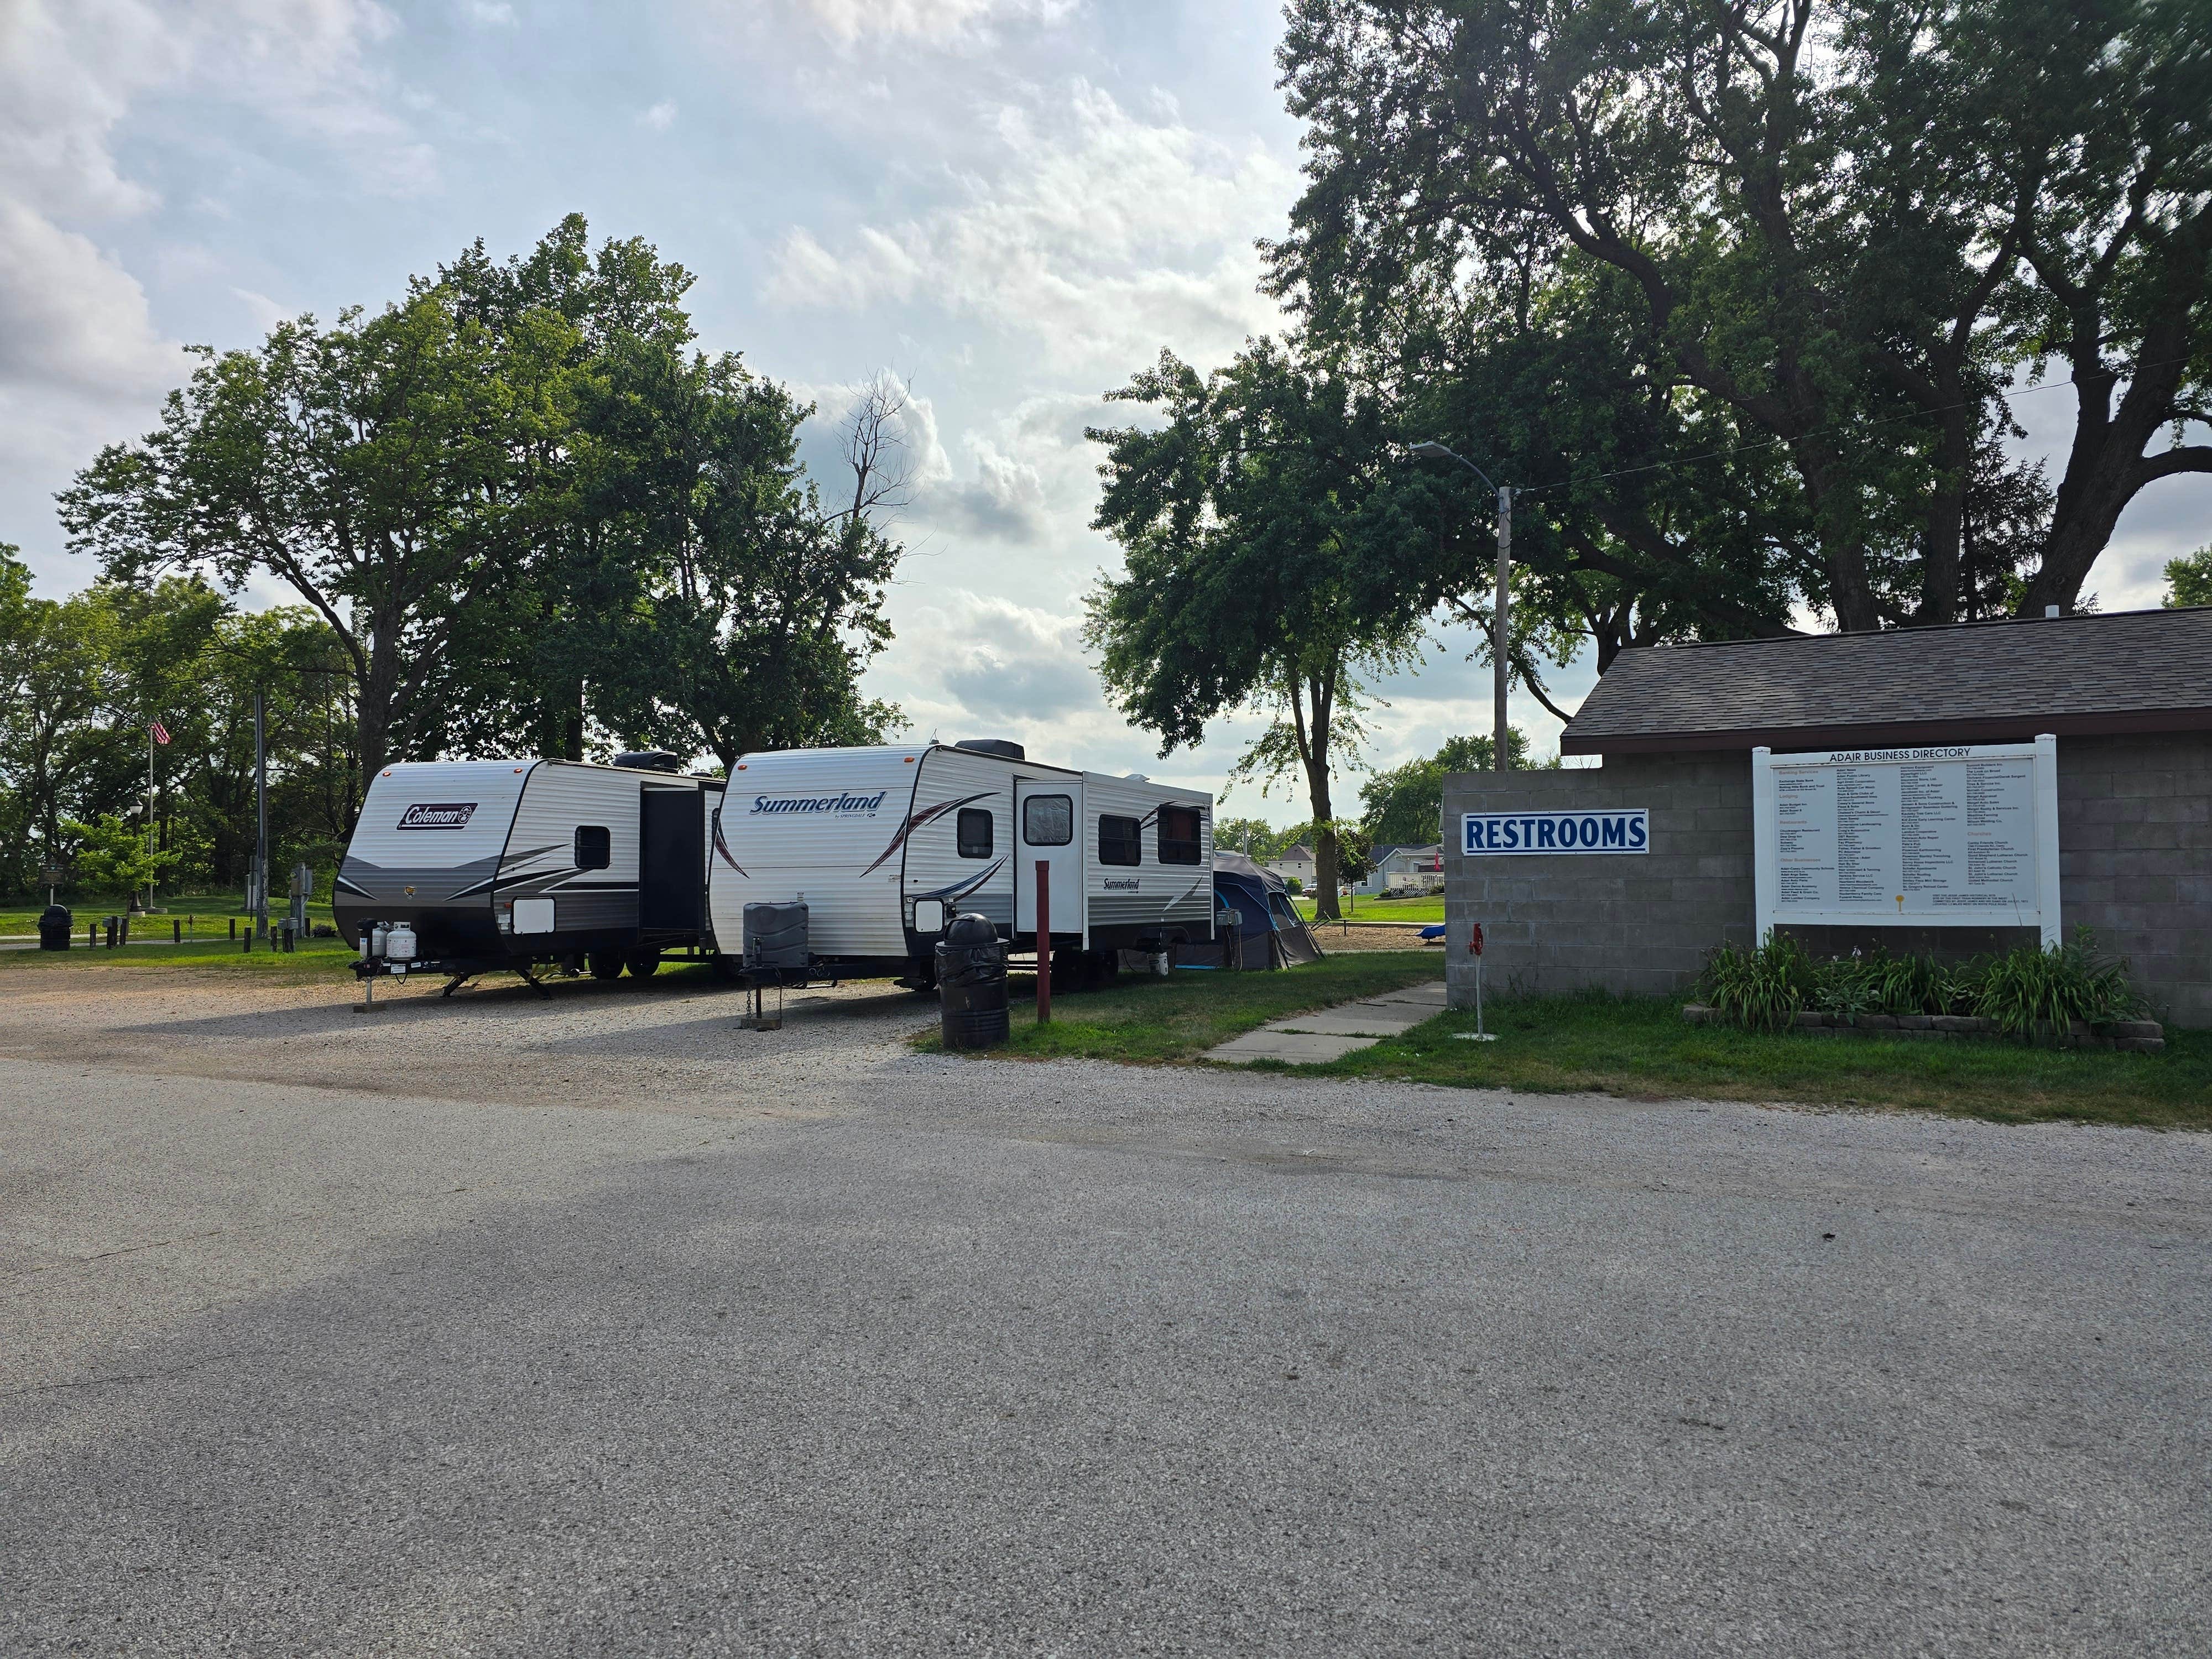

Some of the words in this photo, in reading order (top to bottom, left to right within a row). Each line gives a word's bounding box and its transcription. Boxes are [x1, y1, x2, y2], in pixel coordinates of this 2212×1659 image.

[1829, 753, 1861, 762] ADAIR
[1865, 750, 1910, 760] BUSINESS
[1913, 748, 1970, 758] DIRECTORY
[749, 791, 888, 815] Summerland
[405, 806, 458, 824] Coleman
[1467, 817, 1646, 848] RESTROOMS
[1103, 878, 1140, 890] Summerland
